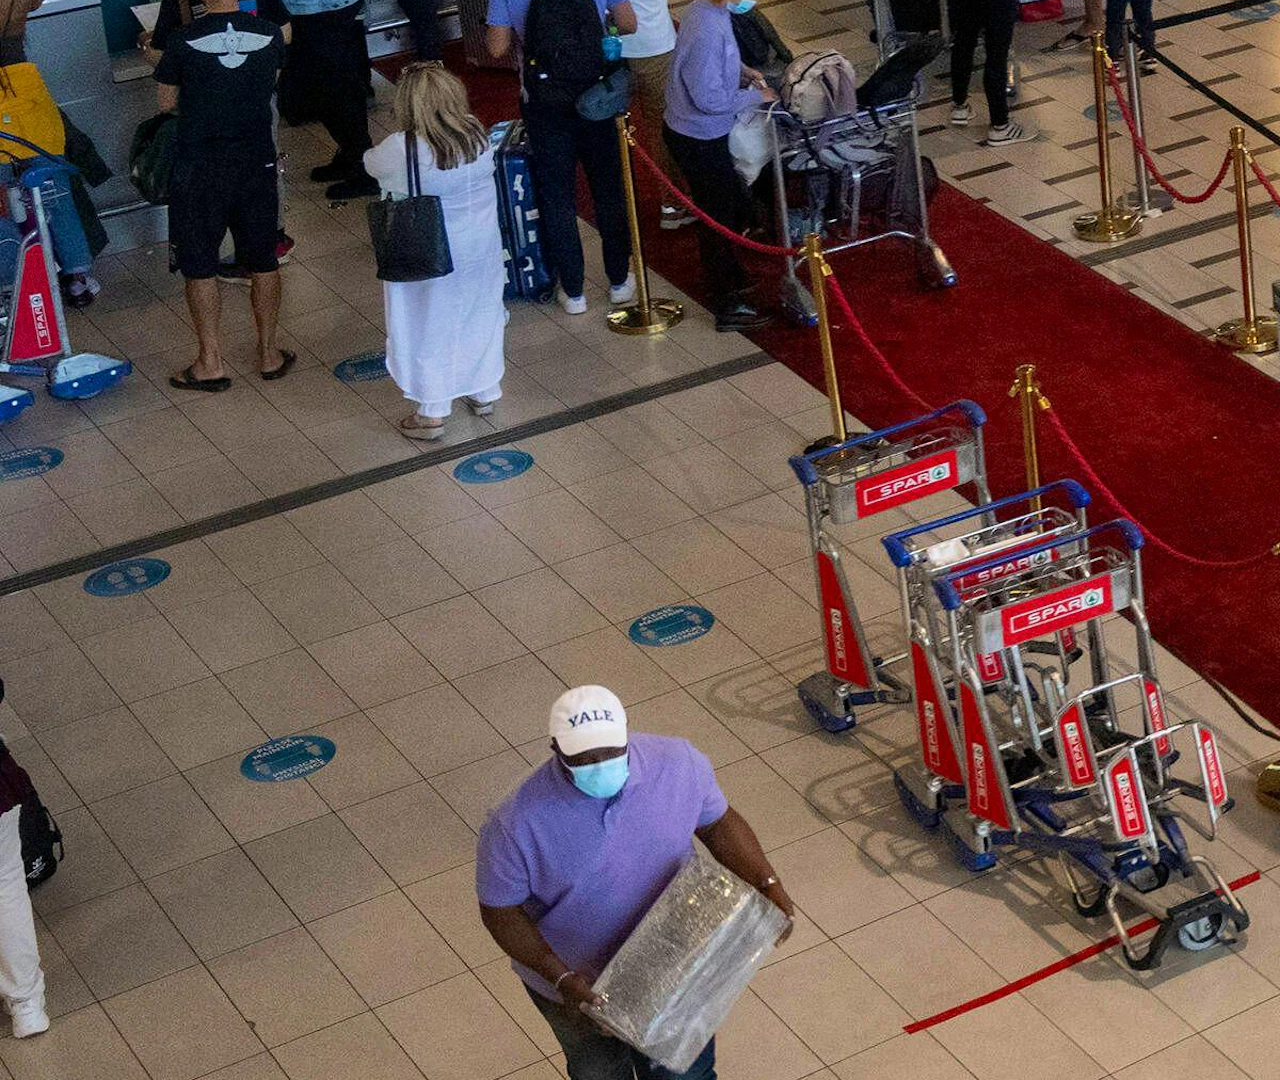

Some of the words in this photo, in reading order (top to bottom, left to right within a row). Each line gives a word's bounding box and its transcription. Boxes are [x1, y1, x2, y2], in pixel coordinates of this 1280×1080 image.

[34, 305, 47, 338] SPAR
[880, 471, 930, 498] SPAR
[977, 556, 1031, 584] SPAR
[638, 608, 685, 627] MAINTAIN
[1027, 597, 1081, 626] SPAR
[658, 625, 701, 642] PHYSICAL
[835, 620, 845, 659] SPAR
[568, 709, 614, 729] YALE
[256, 739, 291, 754] PLEASE
[928, 713, 937, 753] SPAR
[252, 738, 306, 759] MAINTAIN
[1070, 736, 1085, 768] SPAR
[272, 758, 321, 778] PHYSICAL
[275, 760, 326, 781] DISTANCE
[975, 757, 986, 794] SPAR
[1121, 785, 1135, 823] SPAR
